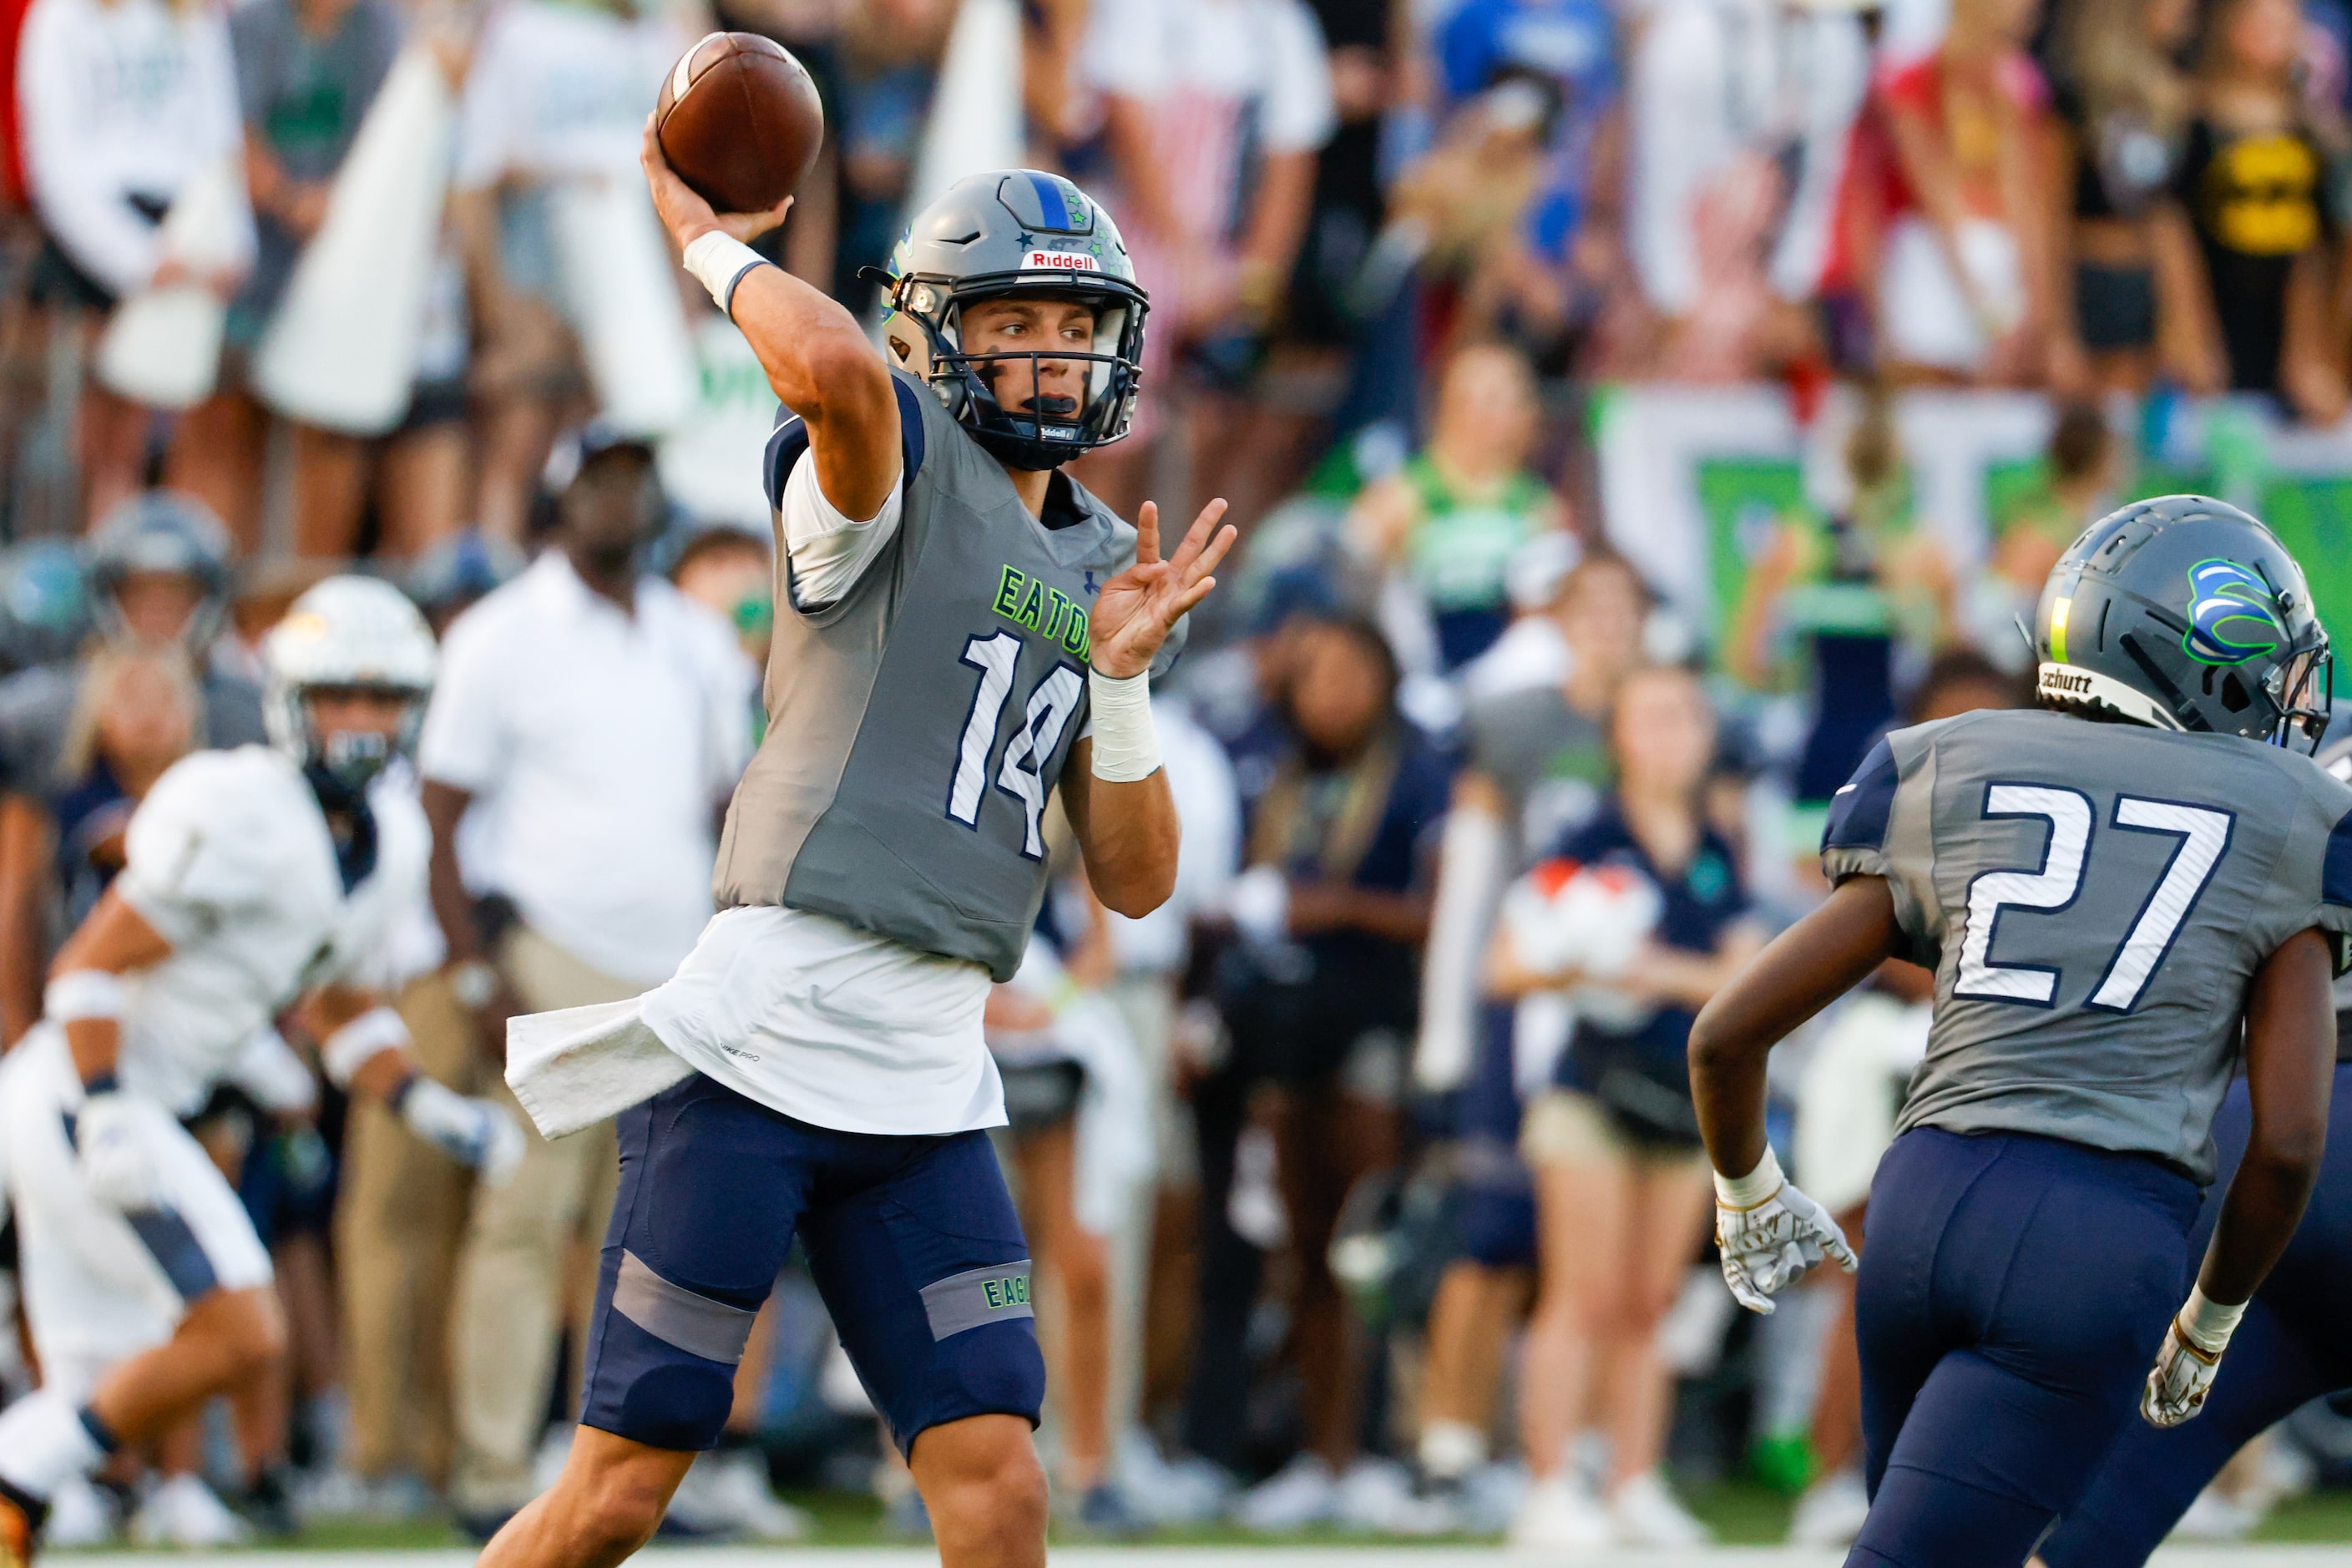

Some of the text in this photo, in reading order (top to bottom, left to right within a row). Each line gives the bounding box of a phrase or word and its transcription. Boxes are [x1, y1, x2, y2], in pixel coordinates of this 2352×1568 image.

[1033, 253, 1093, 270] Riddell
[1040, 427, 1066, 438] iddell
[945, 626, 1085, 864] 14
[1952, 781, 2237, 1016] 27
[738, 1051, 760, 1062] PRO
